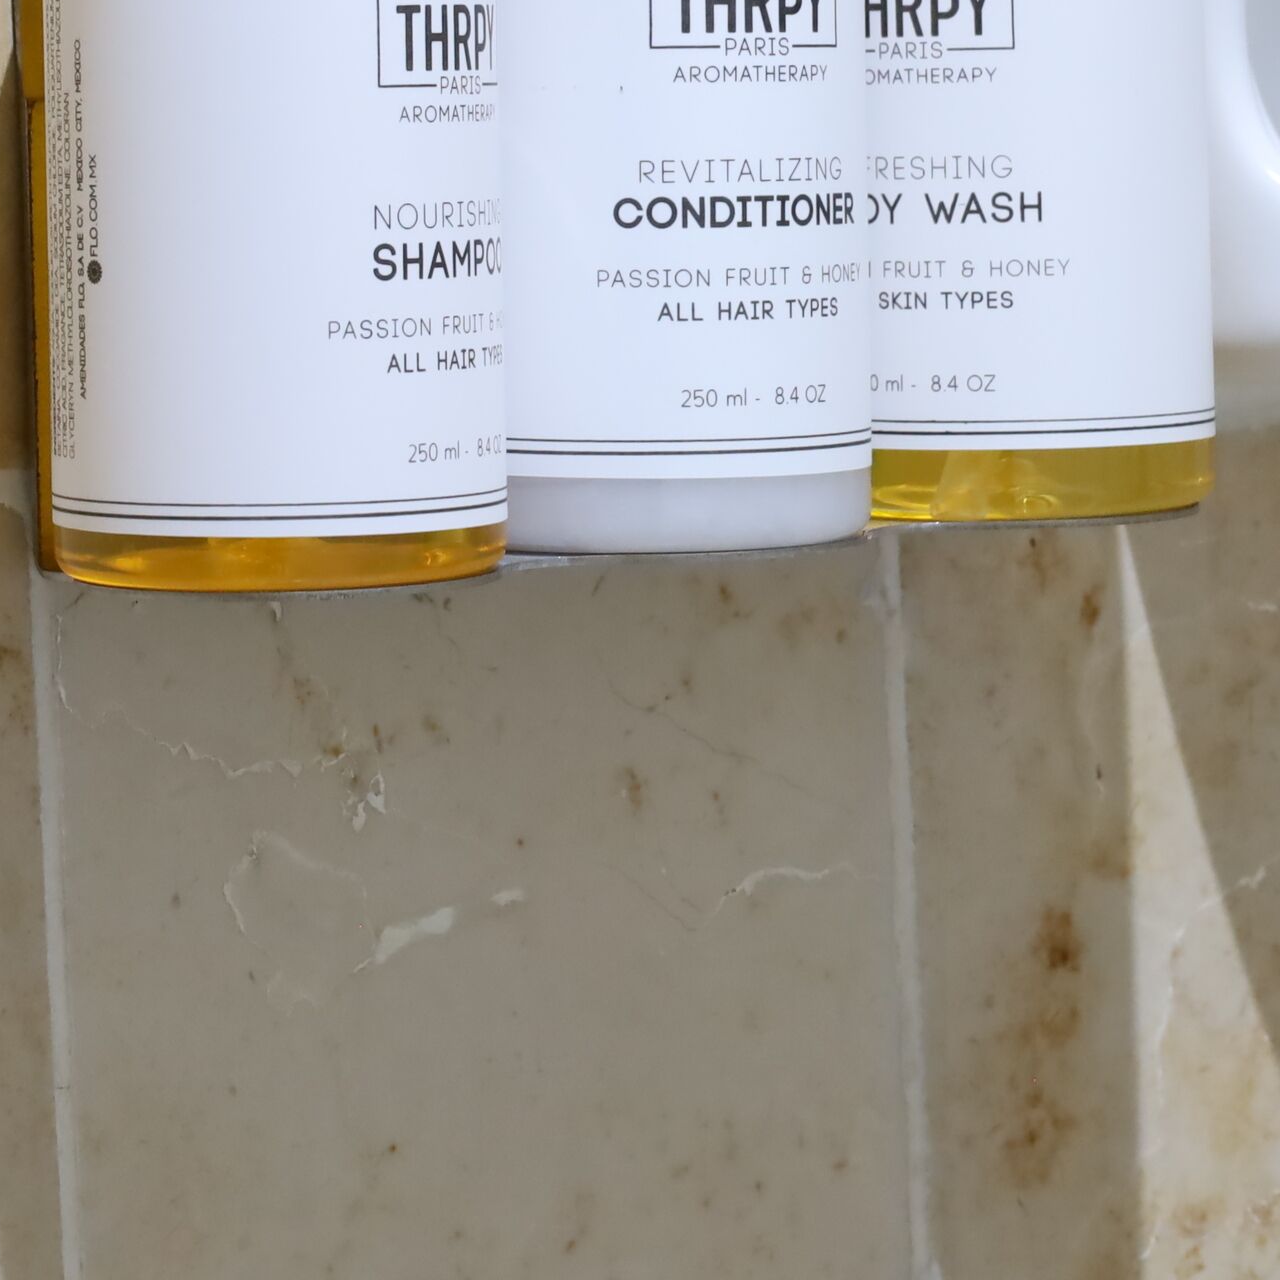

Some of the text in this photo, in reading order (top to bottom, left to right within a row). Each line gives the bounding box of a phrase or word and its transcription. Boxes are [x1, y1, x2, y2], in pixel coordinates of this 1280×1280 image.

[396, 4, 494, 71] THRPY
[724, 37, 790, 57] PARIS
[878, 41, 943, 60] PARIS
[73, 39, 82, 93] MEXICO
[672, 65, 828, 84] AROMATHERAPY
[865, 67, 998, 85] OMATHERAPY
[440, 75, 481, 95] PARIS
[75, 138, 84, 191] MEXICO
[638, 156, 842, 184] REVITALIZING
[867, 154, 1013, 180] RESHING
[613, 192, 855, 229] CONDITIONER
[924, 191, 1043, 224] WASH
[77, 233, 84, 250] DE
[597, 268, 711, 289] PASSION
[725, 266, 790, 287] FRUIT
[801, 265, 812, 285] &
[821, 262, 860, 284] HONEY
[883, 260, 947, 280] FRUIT
[961, 260, 975, 278] &
[989, 258, 1070, 278] HONEY
[657, 297, 838, 322] ALL HAIR TYPES
[878, 290, 1014, 310] SKIN TYPES
[328, 317, 432, 340] PASSION
[443, 313, 484, 335] FRUIT
[78, 314, 87, 400] AMENIDADES
[387, 344, 503, 374] ALL HAIR TYPES
[885, 374, 903, 392] ml
[931, 374, 959, 393] 8.4
[966, 373, 996, 392] OZ
[680, 389, 718, 409] 250
[726, 387, 747, 407] ml
[775, 386, 799, 405] 8.4
[804, 384, 826, 404] OZ
[408, 443, 438, 463] 250
[444, 440, 460, 461] ml
